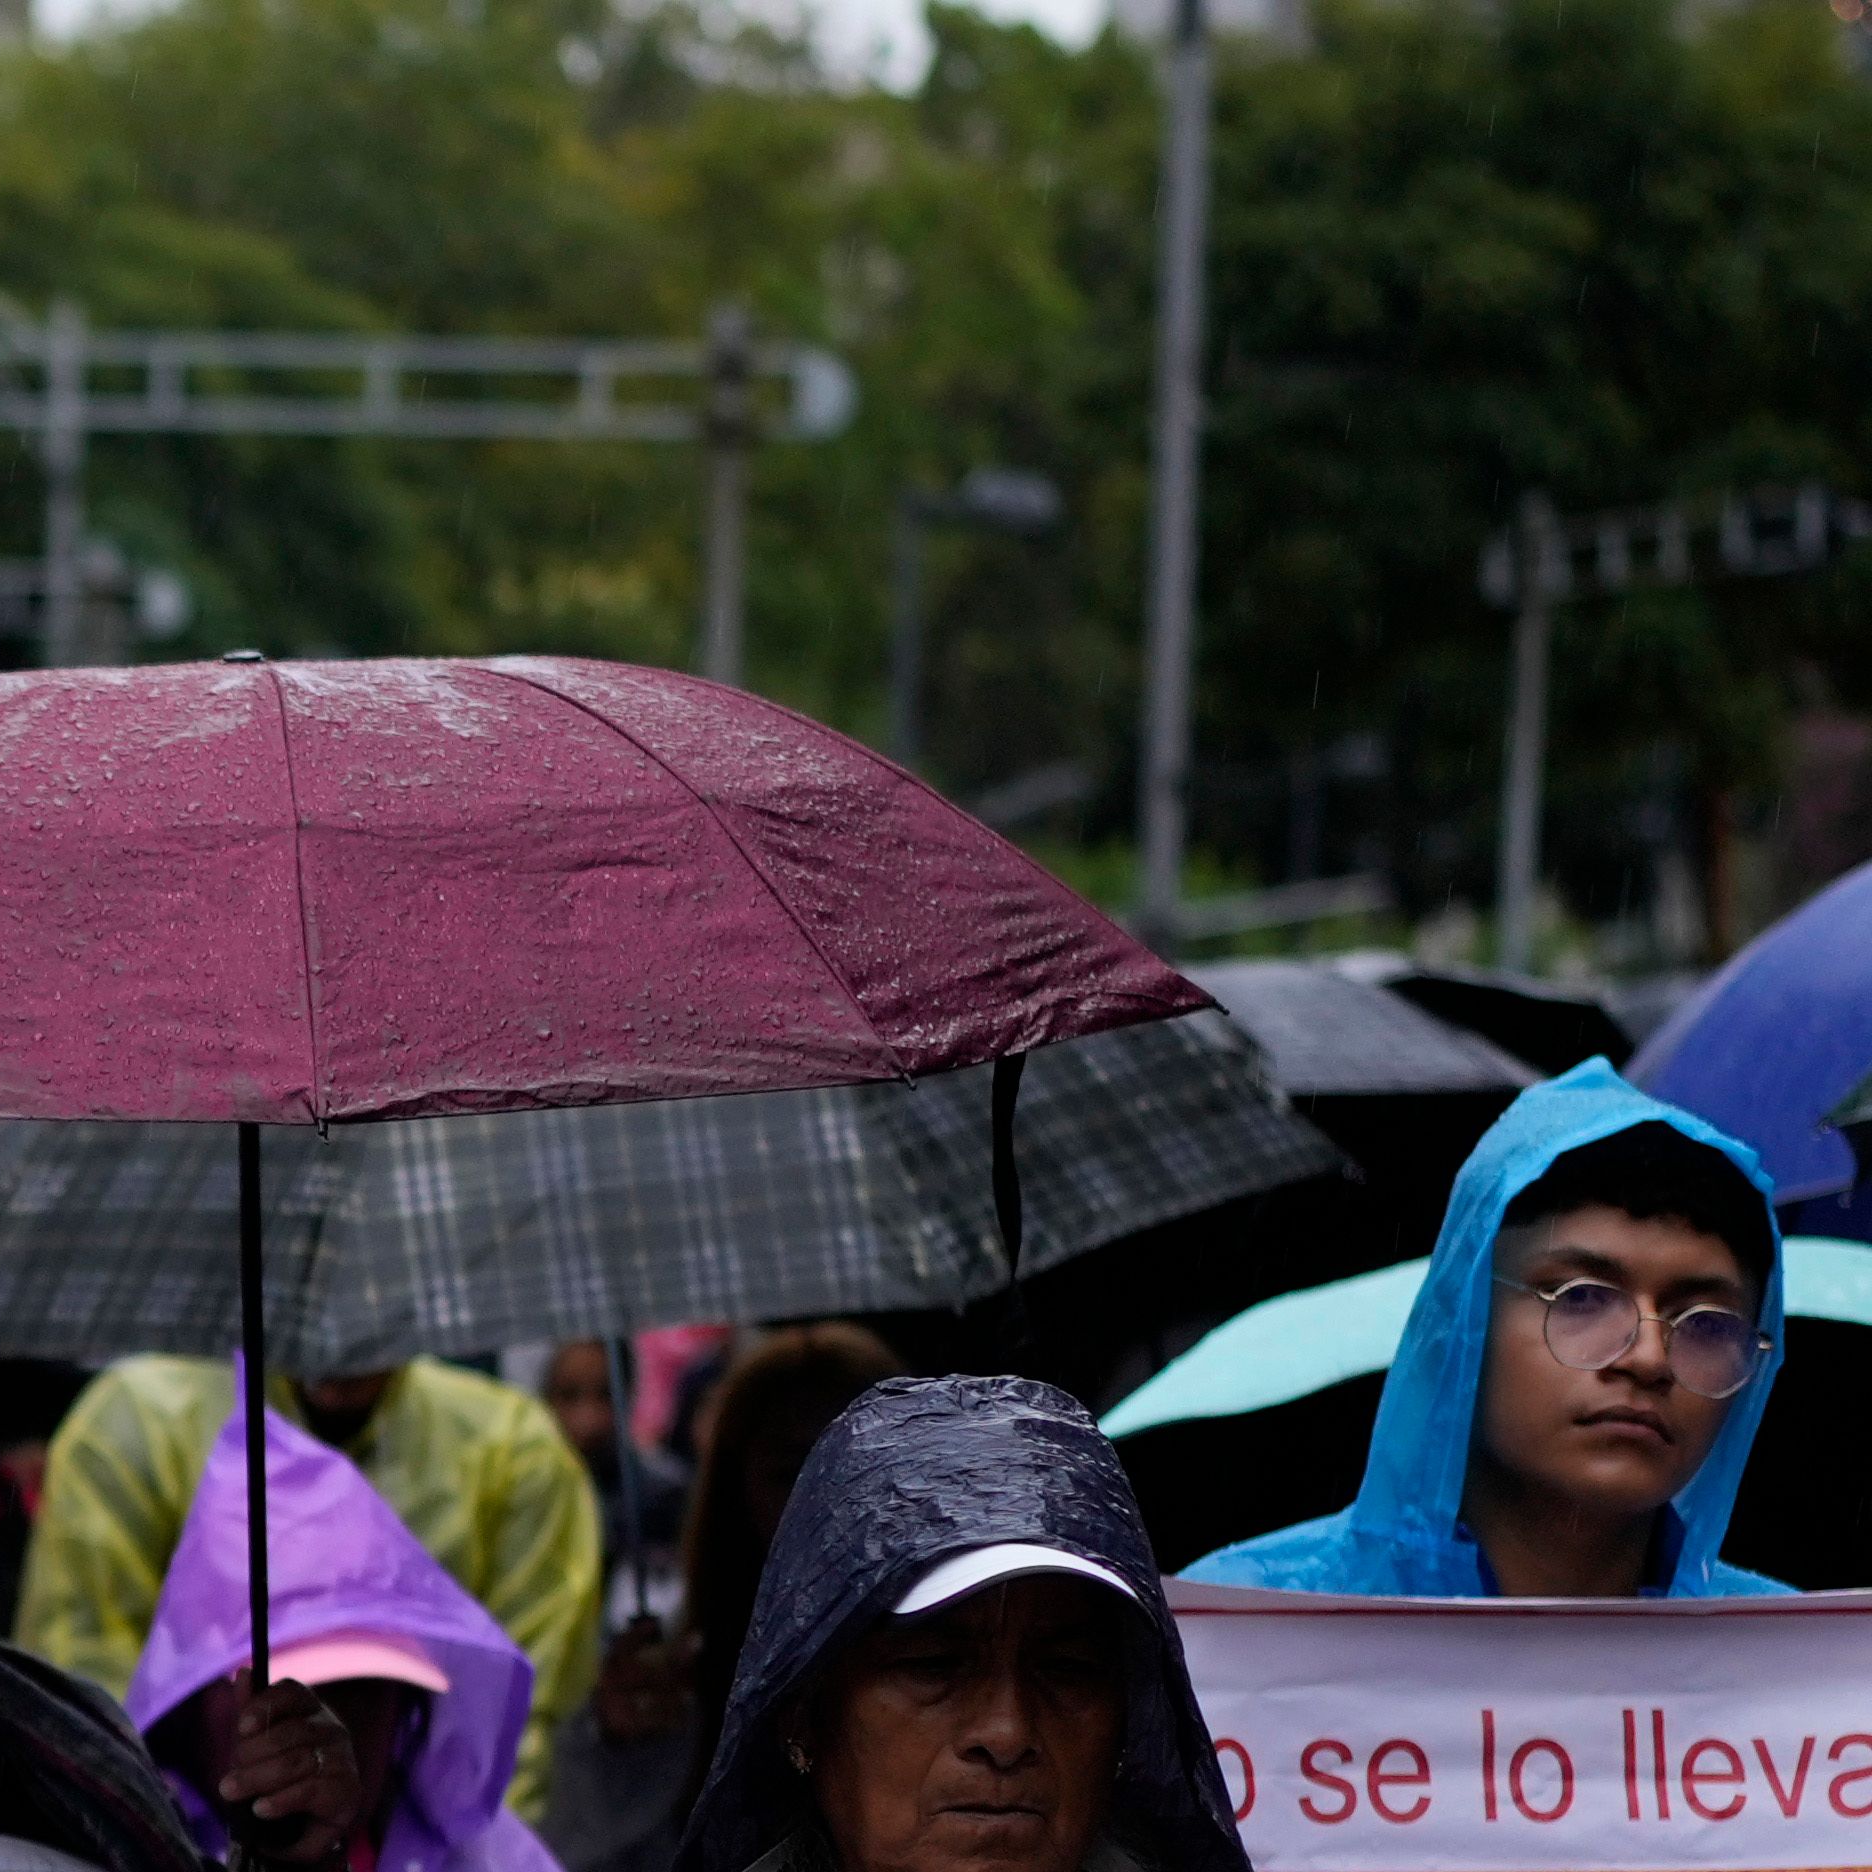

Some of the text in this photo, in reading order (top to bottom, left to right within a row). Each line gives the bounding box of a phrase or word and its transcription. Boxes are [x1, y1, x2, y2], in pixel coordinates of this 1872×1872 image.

[1298, 1737, 1433, 1826] se
[1481, 1709, 1575, 1824] lo
[1622, 1707, 1872, 1822] lleva
